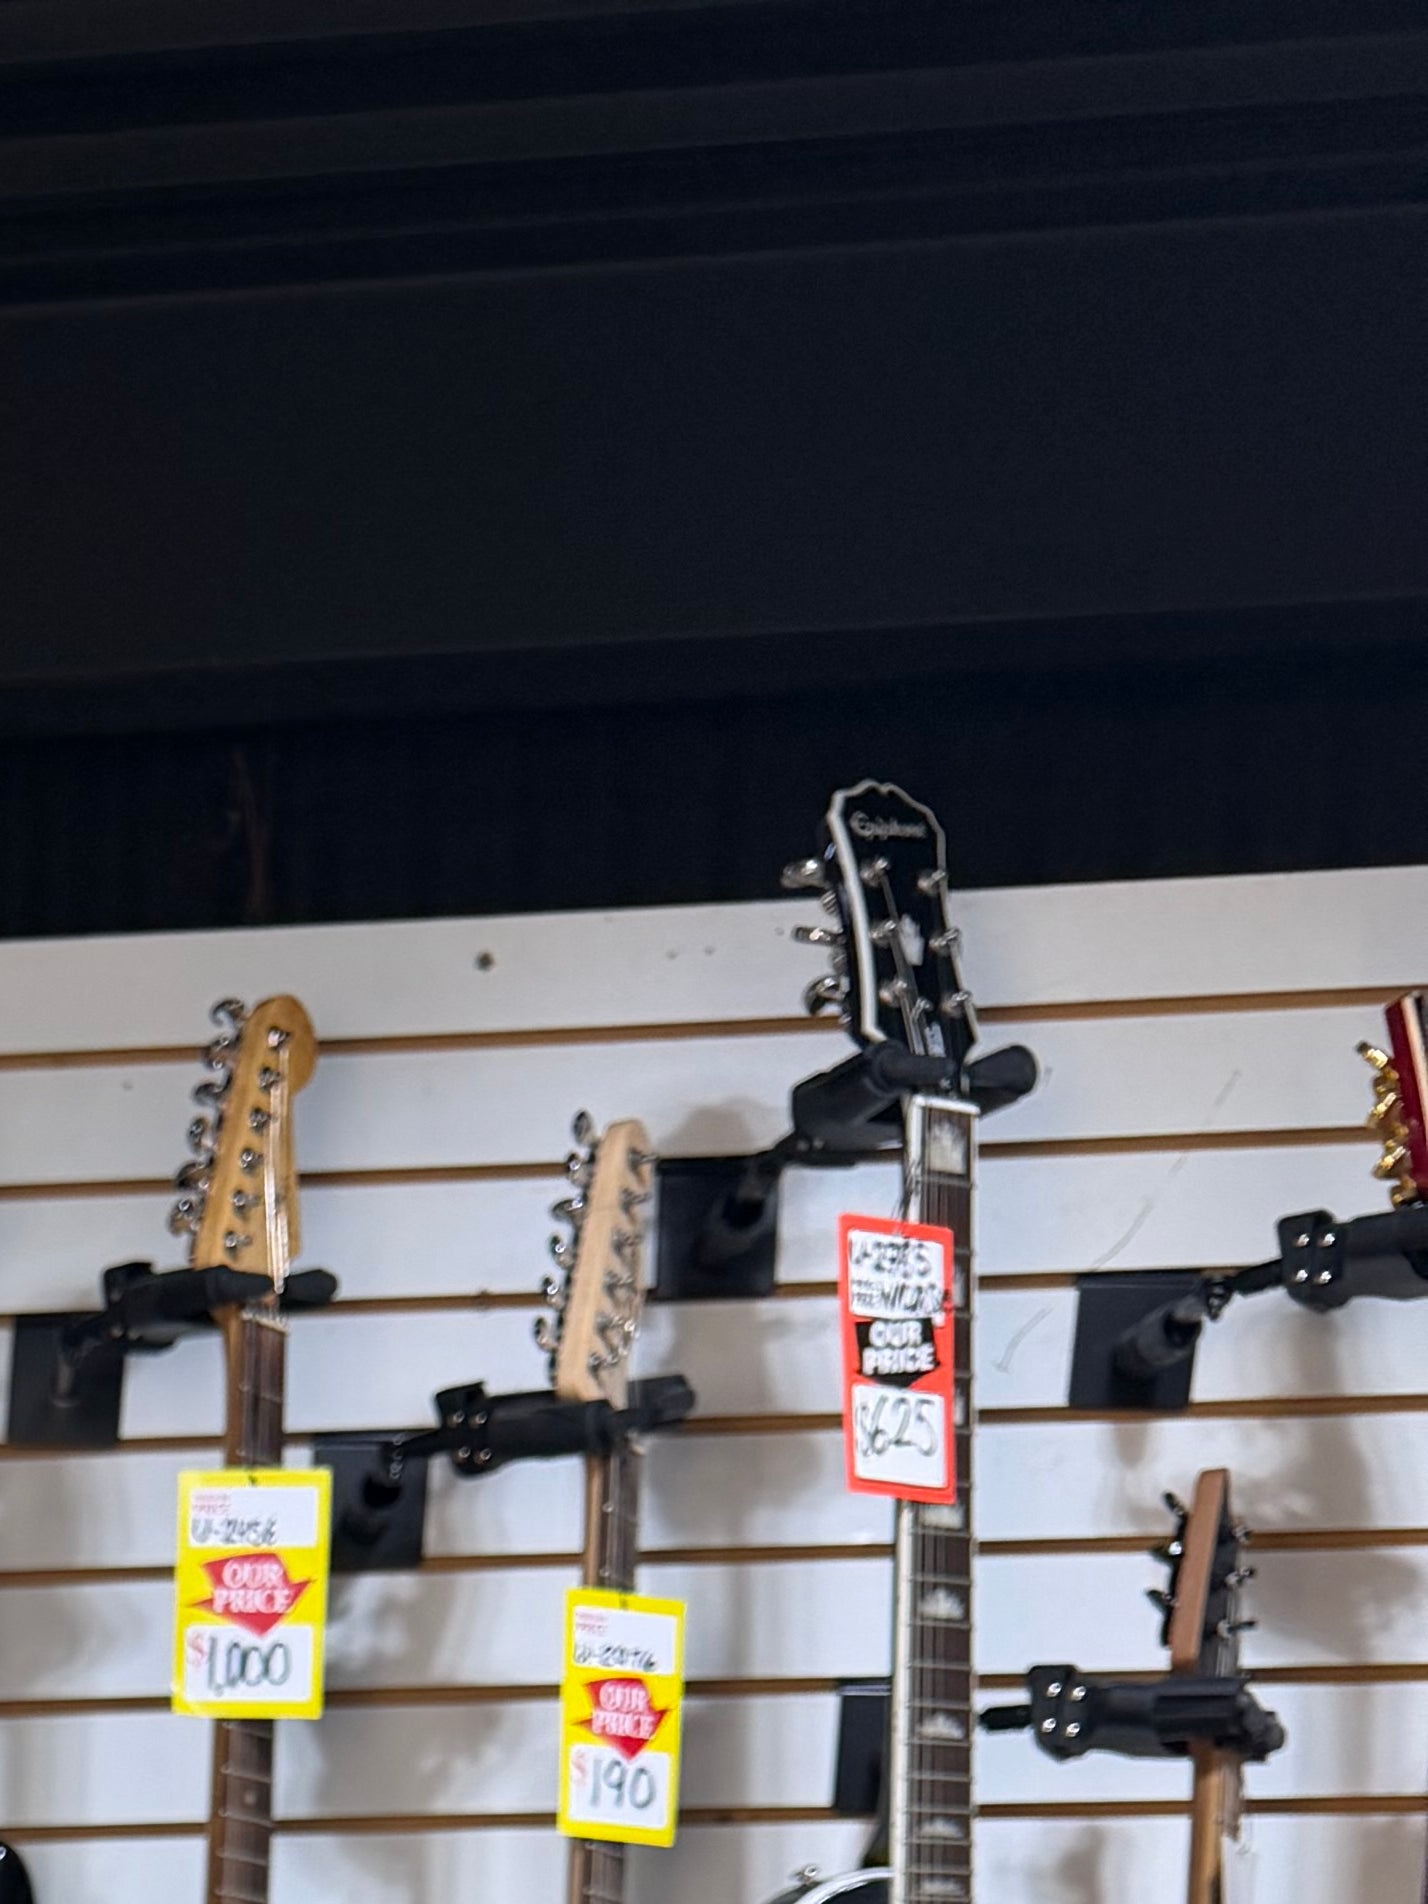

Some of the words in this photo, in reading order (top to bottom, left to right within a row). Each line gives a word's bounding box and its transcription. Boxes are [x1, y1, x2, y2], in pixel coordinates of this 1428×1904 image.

[868, 1319, 923, 1349] OUR
[861, 1344, 937, 1377] PRICE
[222, 1559, 285, 1589] OUR
[211, 1588, 294, 1615] PRICE
[598, 1680, 651, 1713] OUR
[590, 1711, 657, 1741] PRICE
